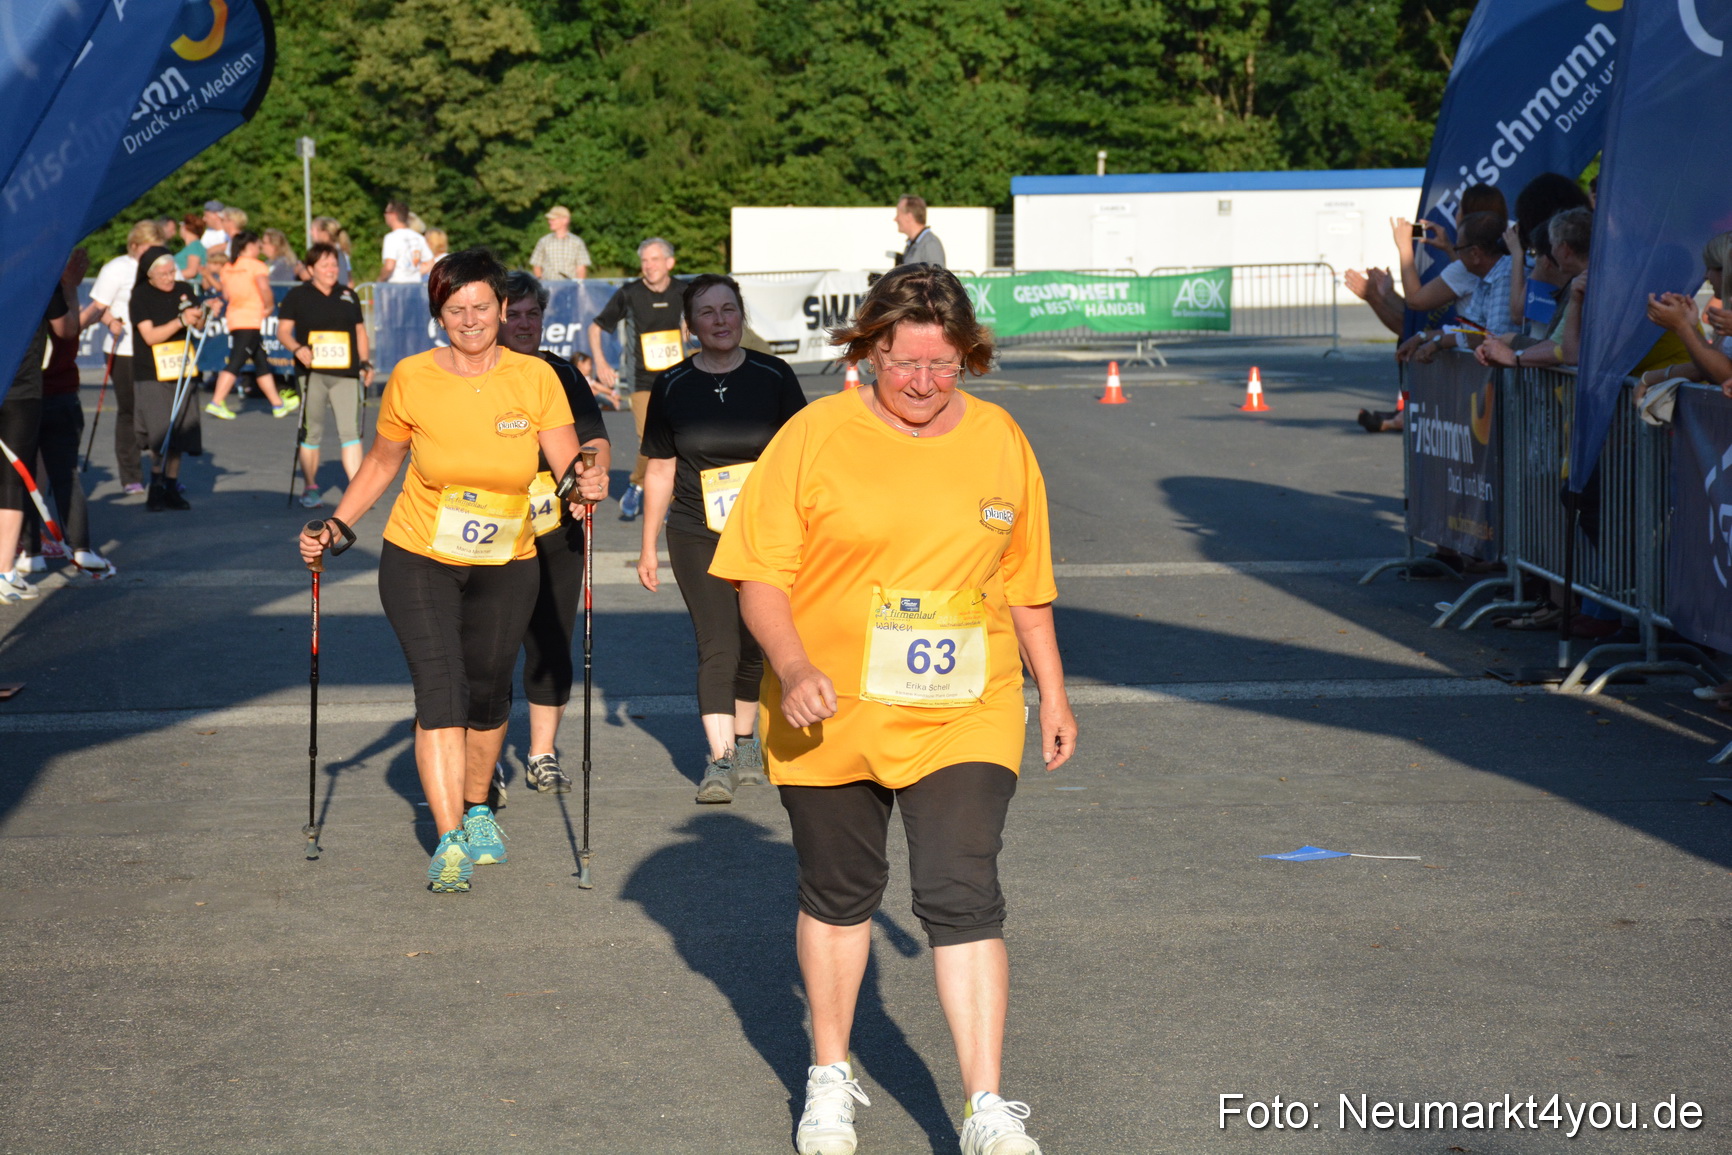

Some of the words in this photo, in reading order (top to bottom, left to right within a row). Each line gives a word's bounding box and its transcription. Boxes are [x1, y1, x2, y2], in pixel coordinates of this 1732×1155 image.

[122, 113, 170, 155] Druck
[200, 52, 257, 104] Medien
[1554, 82, 1602, 133] Druck
[1435, 22, 1617, 230] Frischmann
[1013, 282, 1130, 303] GESUNDHEIT
[1173, 278, 1226, 309] AOK
[461, 519, 499, 545] 62
[890, 609, 937, 620] firmenlauf
[906, 638, 956, 675] 63
[905, 681, 927, 691] Erika
[928, 682, 950, 692] Schell
